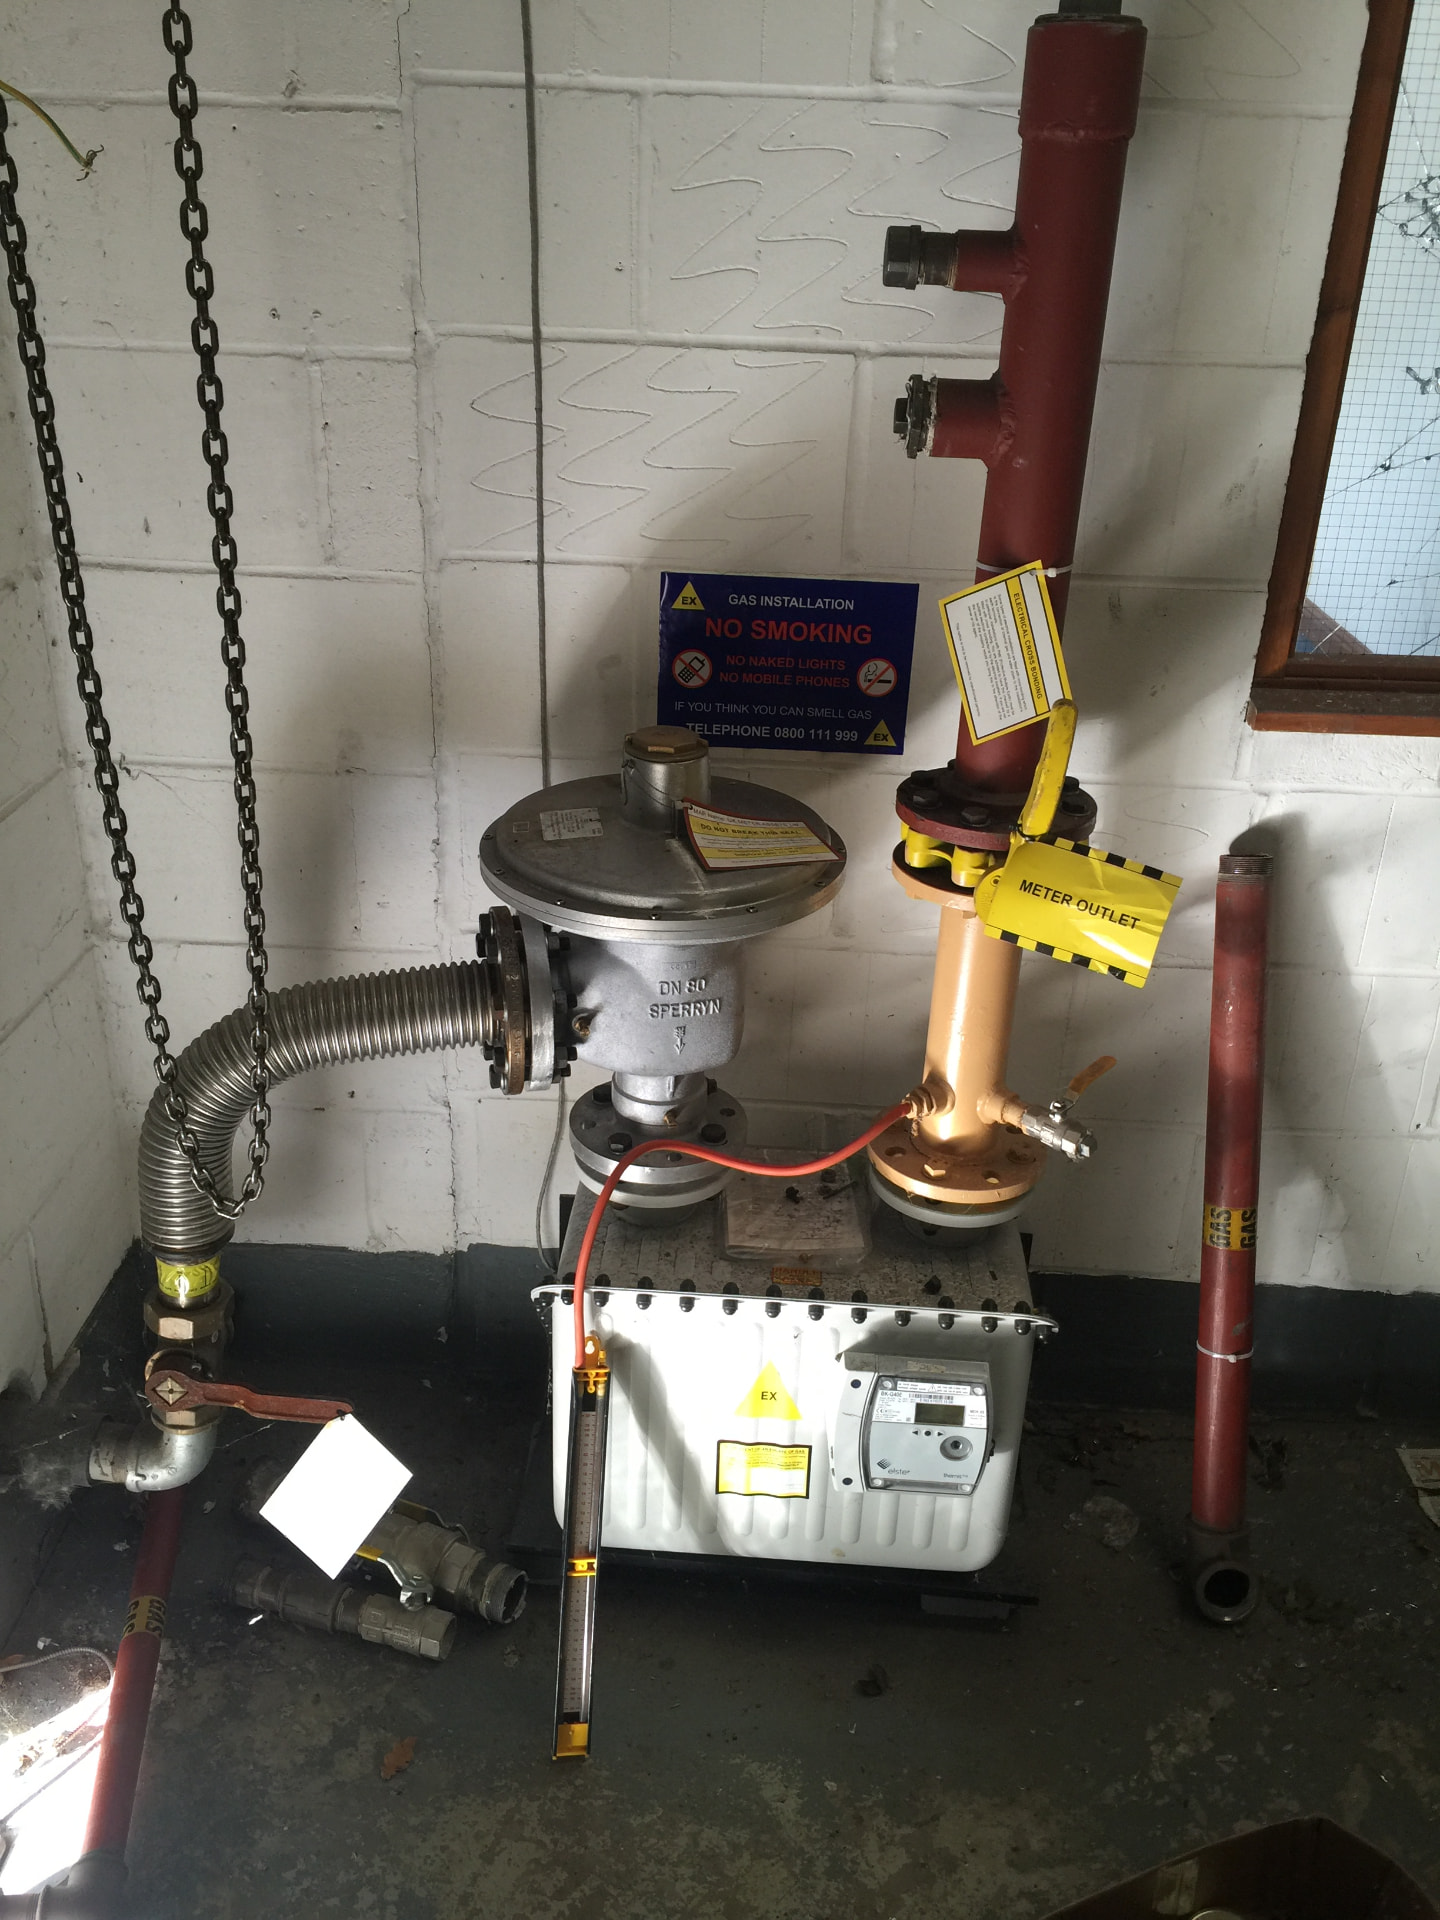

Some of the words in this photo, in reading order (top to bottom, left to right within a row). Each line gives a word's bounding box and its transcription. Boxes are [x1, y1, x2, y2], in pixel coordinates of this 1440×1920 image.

[681, 596, 697, 606] EX
[728, 594, 757, 606] GAS
[760, 595, 855, 611] INSTALLATION
[705, 618, 743, 639] NO
[751, 619, 872, 645] SMOKING
[1013, 592, 1027, 639] ELECTRICAL
[1024, 639, 1035, 666] CROSS
[1031, 666, 1043, 699] BONDING
[726, 655, 746, 666] NO
[749, 656, 794, 668] NAKED
[799, 658, 846, 671] LIGHTS
[719, 672, 739, 684] NO
[742, 673, 792, 686] MOBILE
[796, 676, 850, 688] PHONES
[674, 701, 685, 711] IF
[687, 701, 712, 712] YOU
[715, 703, 750, 715] THINK
[753, 705, 777, 716] YOU
[779, 706, 804, 717] CAN
[807, 707, 845, 719] SMELL
[848, 709, 872, 720] GAS
[686, 722, 771, 738] TELEPHONE
[774, 726, 805, 740] 0800
[809, 728, 831, 741] 111
[835, 729, 859, 742] 999
[873, 732, 889, 743] EX
[1018, 879, 1073, 907] METER
[1076, 899, 1141, 930] OUTLET
[659, 980, 682, 995] DN
[684, 977, 707, 994] 80
[648, 996, 721, 1019] SPERRYN
[1209, 1207, 1232, 1249] GAS
[760, 1391, 778, 1401] EX
[887, 1468, 911, 1476] elster
